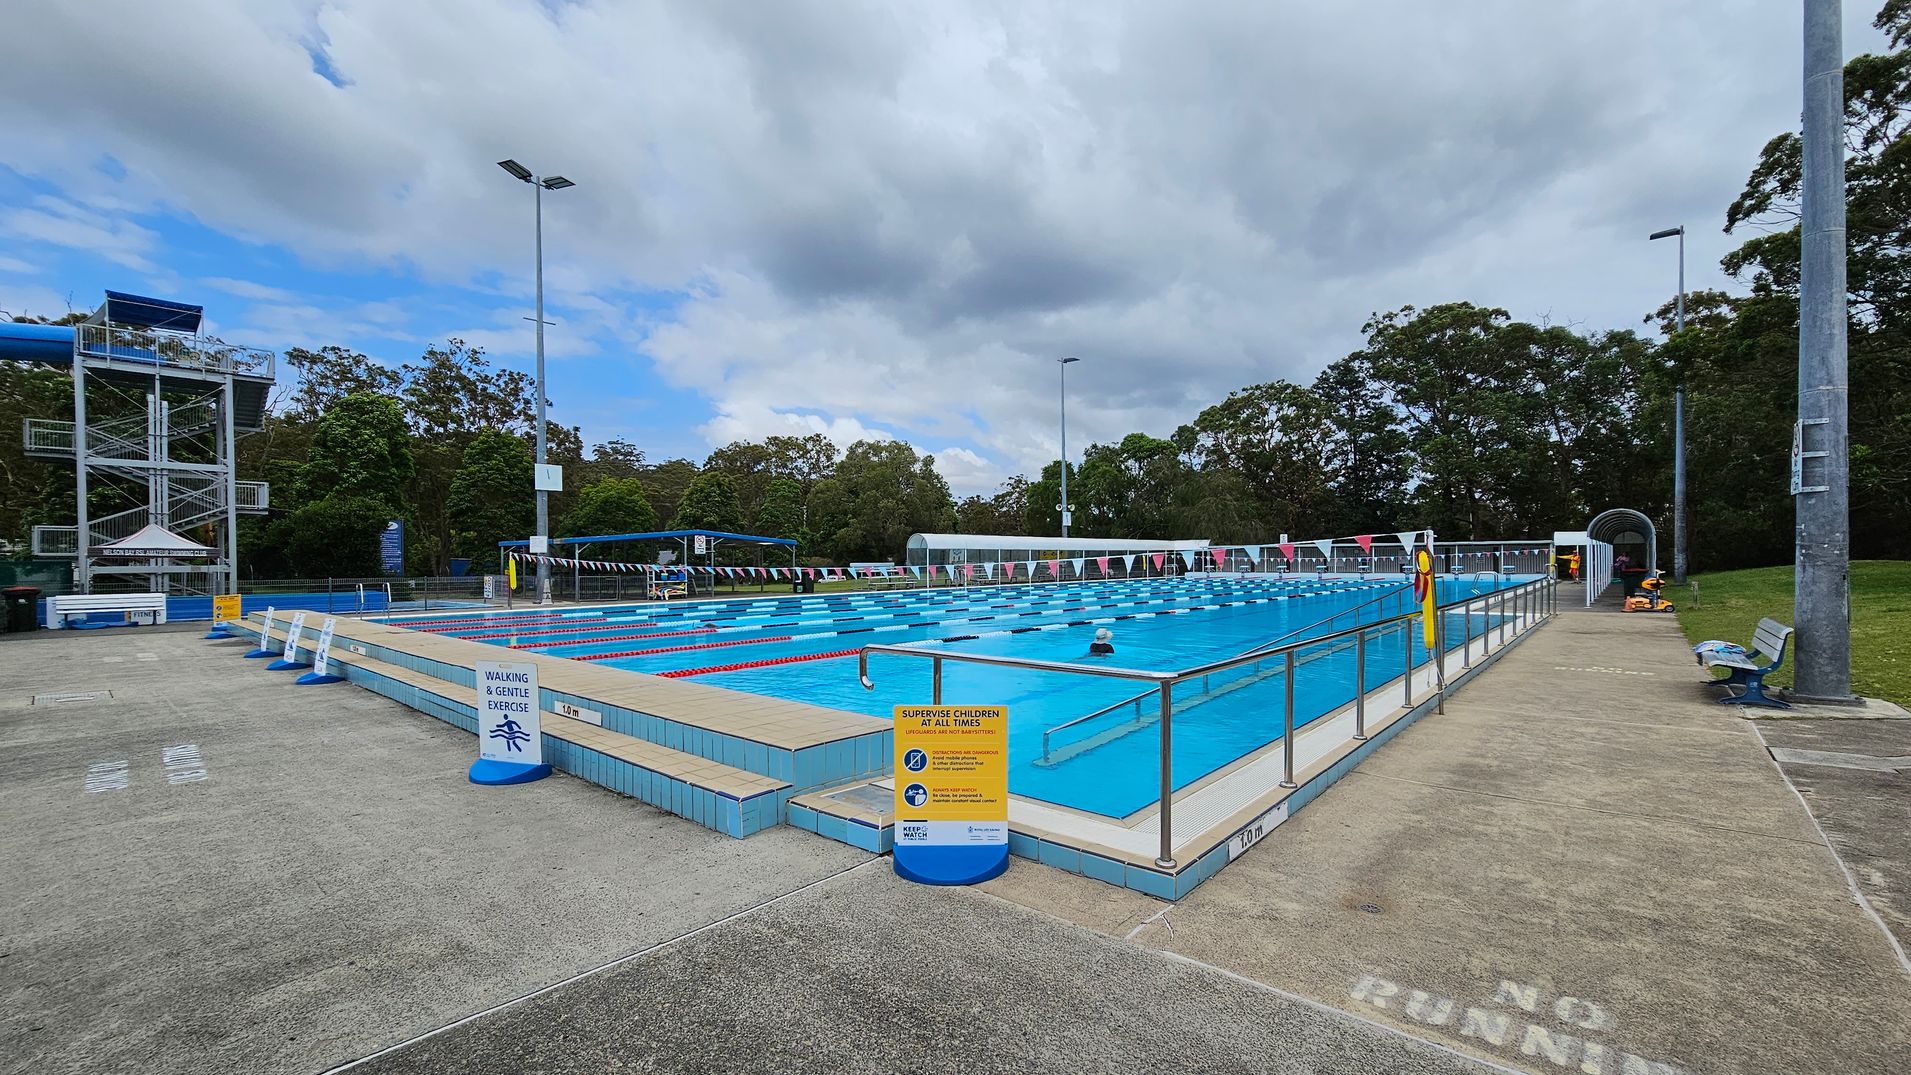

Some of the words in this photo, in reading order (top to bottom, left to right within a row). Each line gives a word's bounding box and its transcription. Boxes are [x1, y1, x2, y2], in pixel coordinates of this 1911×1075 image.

[133, 610, 161, 618] FITNES
[485, 671, 529, 683] WALKING
[486, 685, 493, 695] &
[495, 686, 530, 698] GENTLE
[487, 700, 529, 712] EXERCISE
[562, 704, 571, 715] 1.0
[572, 709, 579, 717] m
[902, 709, 951, 718] SUPERVISE
[953, 709, 1000, 718] CHILDREN
[920, 719, 931, 727] AT
[934, 719, 950, 727] ALL
[953, 719, 980, 727] TIMES
[1240, 829, 1253, 849] 1.0
[1254, 824, 1263, 840] m
[1493, 979, 1616, 1030] NO
